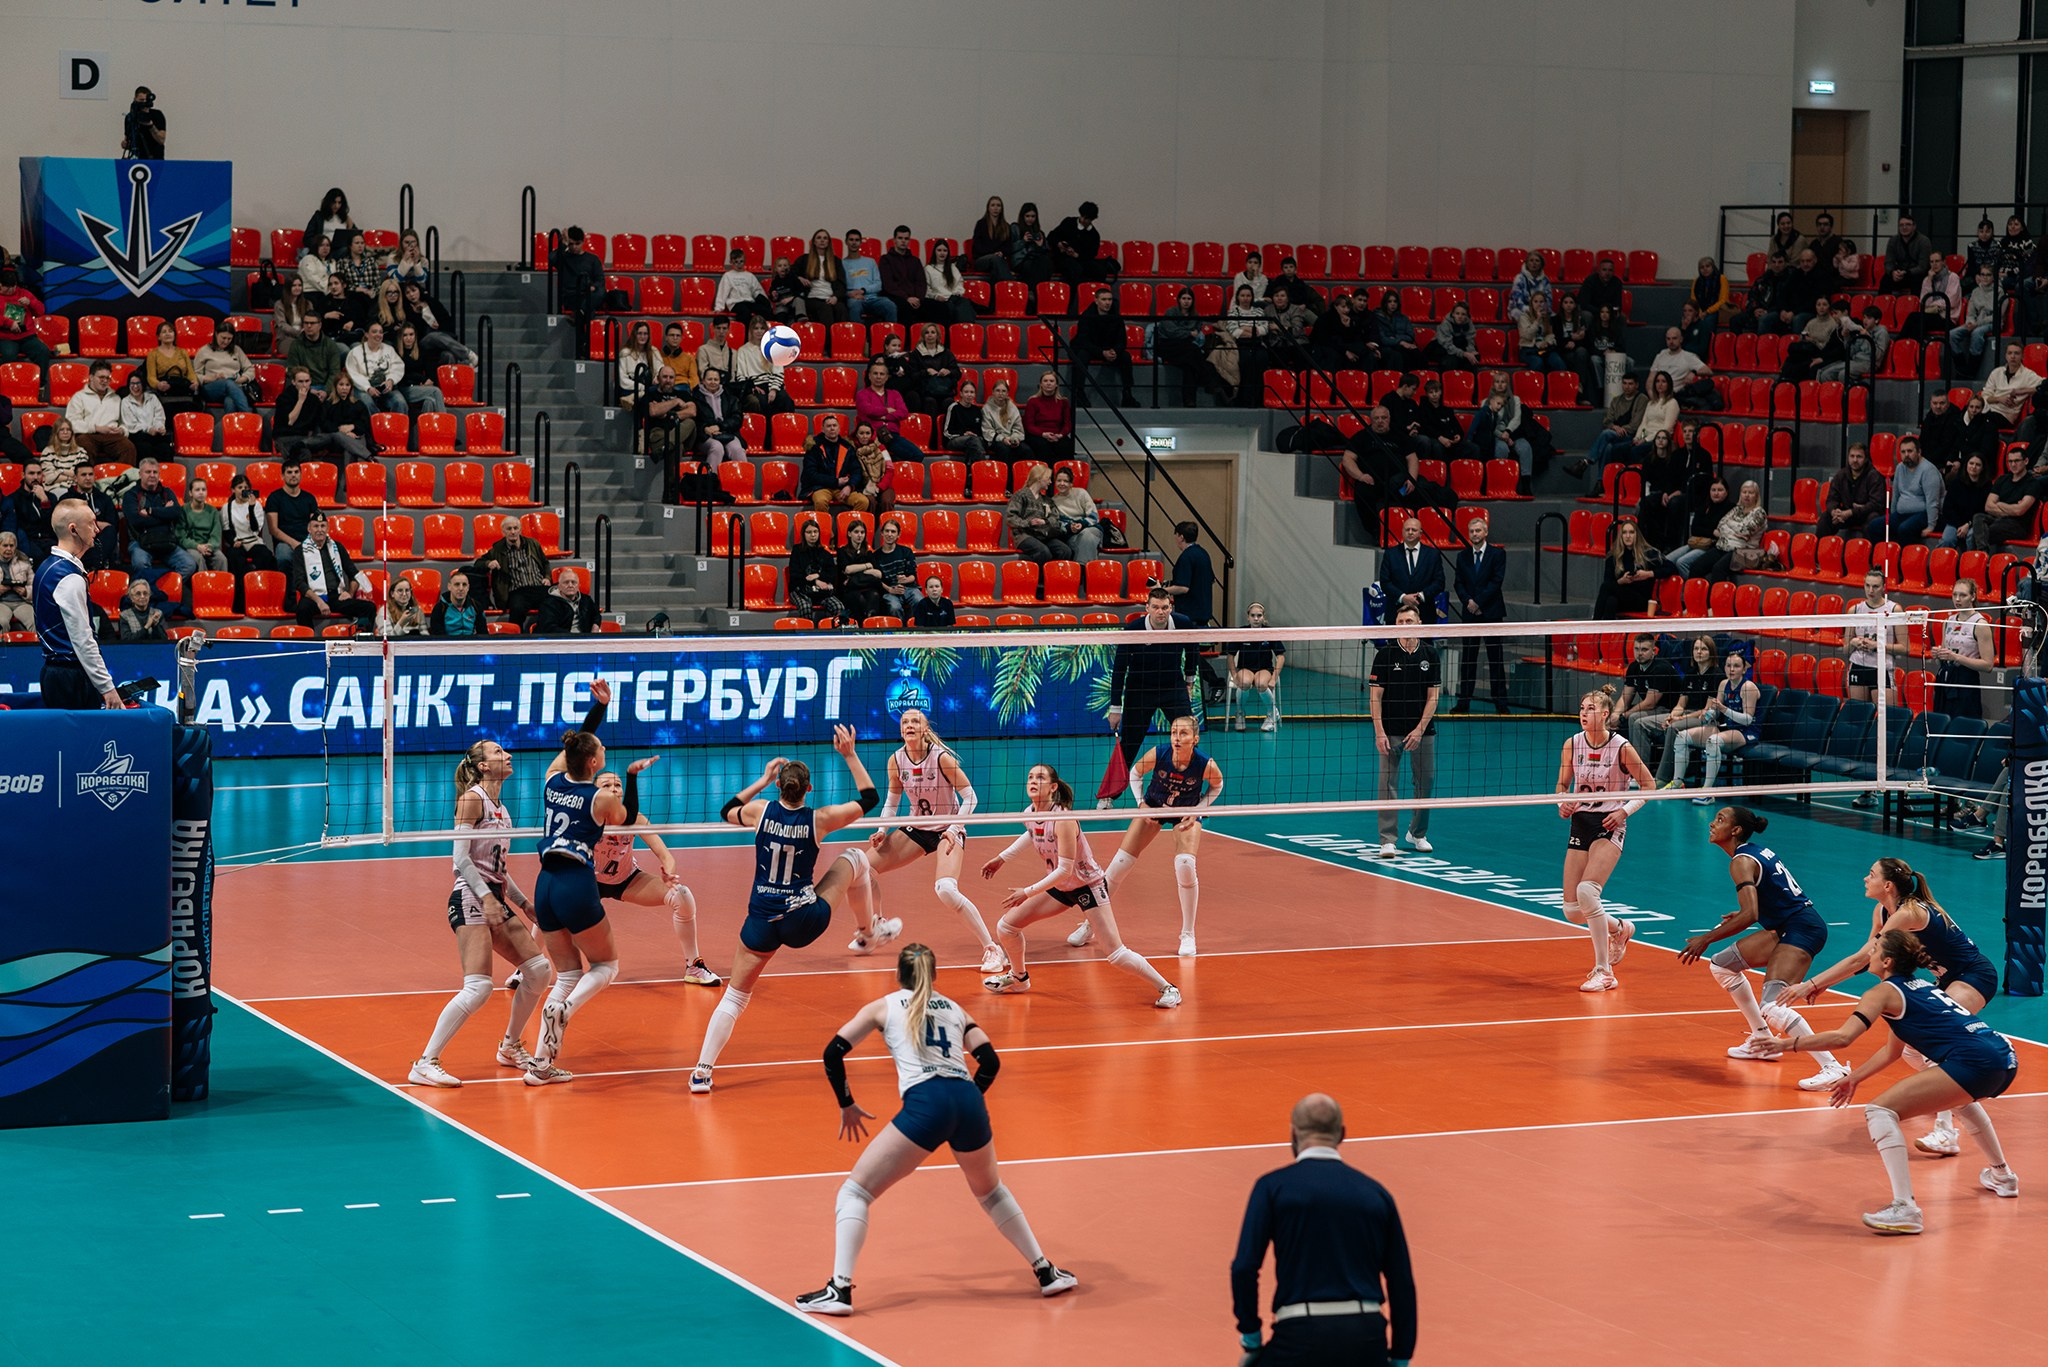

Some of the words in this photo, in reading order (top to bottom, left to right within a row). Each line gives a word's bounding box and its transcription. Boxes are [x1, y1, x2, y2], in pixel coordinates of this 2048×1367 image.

[71, 57, 100, 91] D
[289, 656, 863, 731] САНКТ-ПЕТЕРБУРГ
[0, 774, 45, 794] ВФВ
[80, 775, 145, 790] КОРАБЕЛКА
[545, 807, 570, 837] 12
[2020, 759, 2048, 909] КОРАБЕЛКА
[1569, 836, 1581, 846] 22
[603, 860, 619, 876] 4
[768, 841, 795, 886] 11
[172, 819, 208, 999] КОРАБЕЛКА
[1930, 988, 1971, 1016] 5
[925, 1014, 952, 1059] 4
